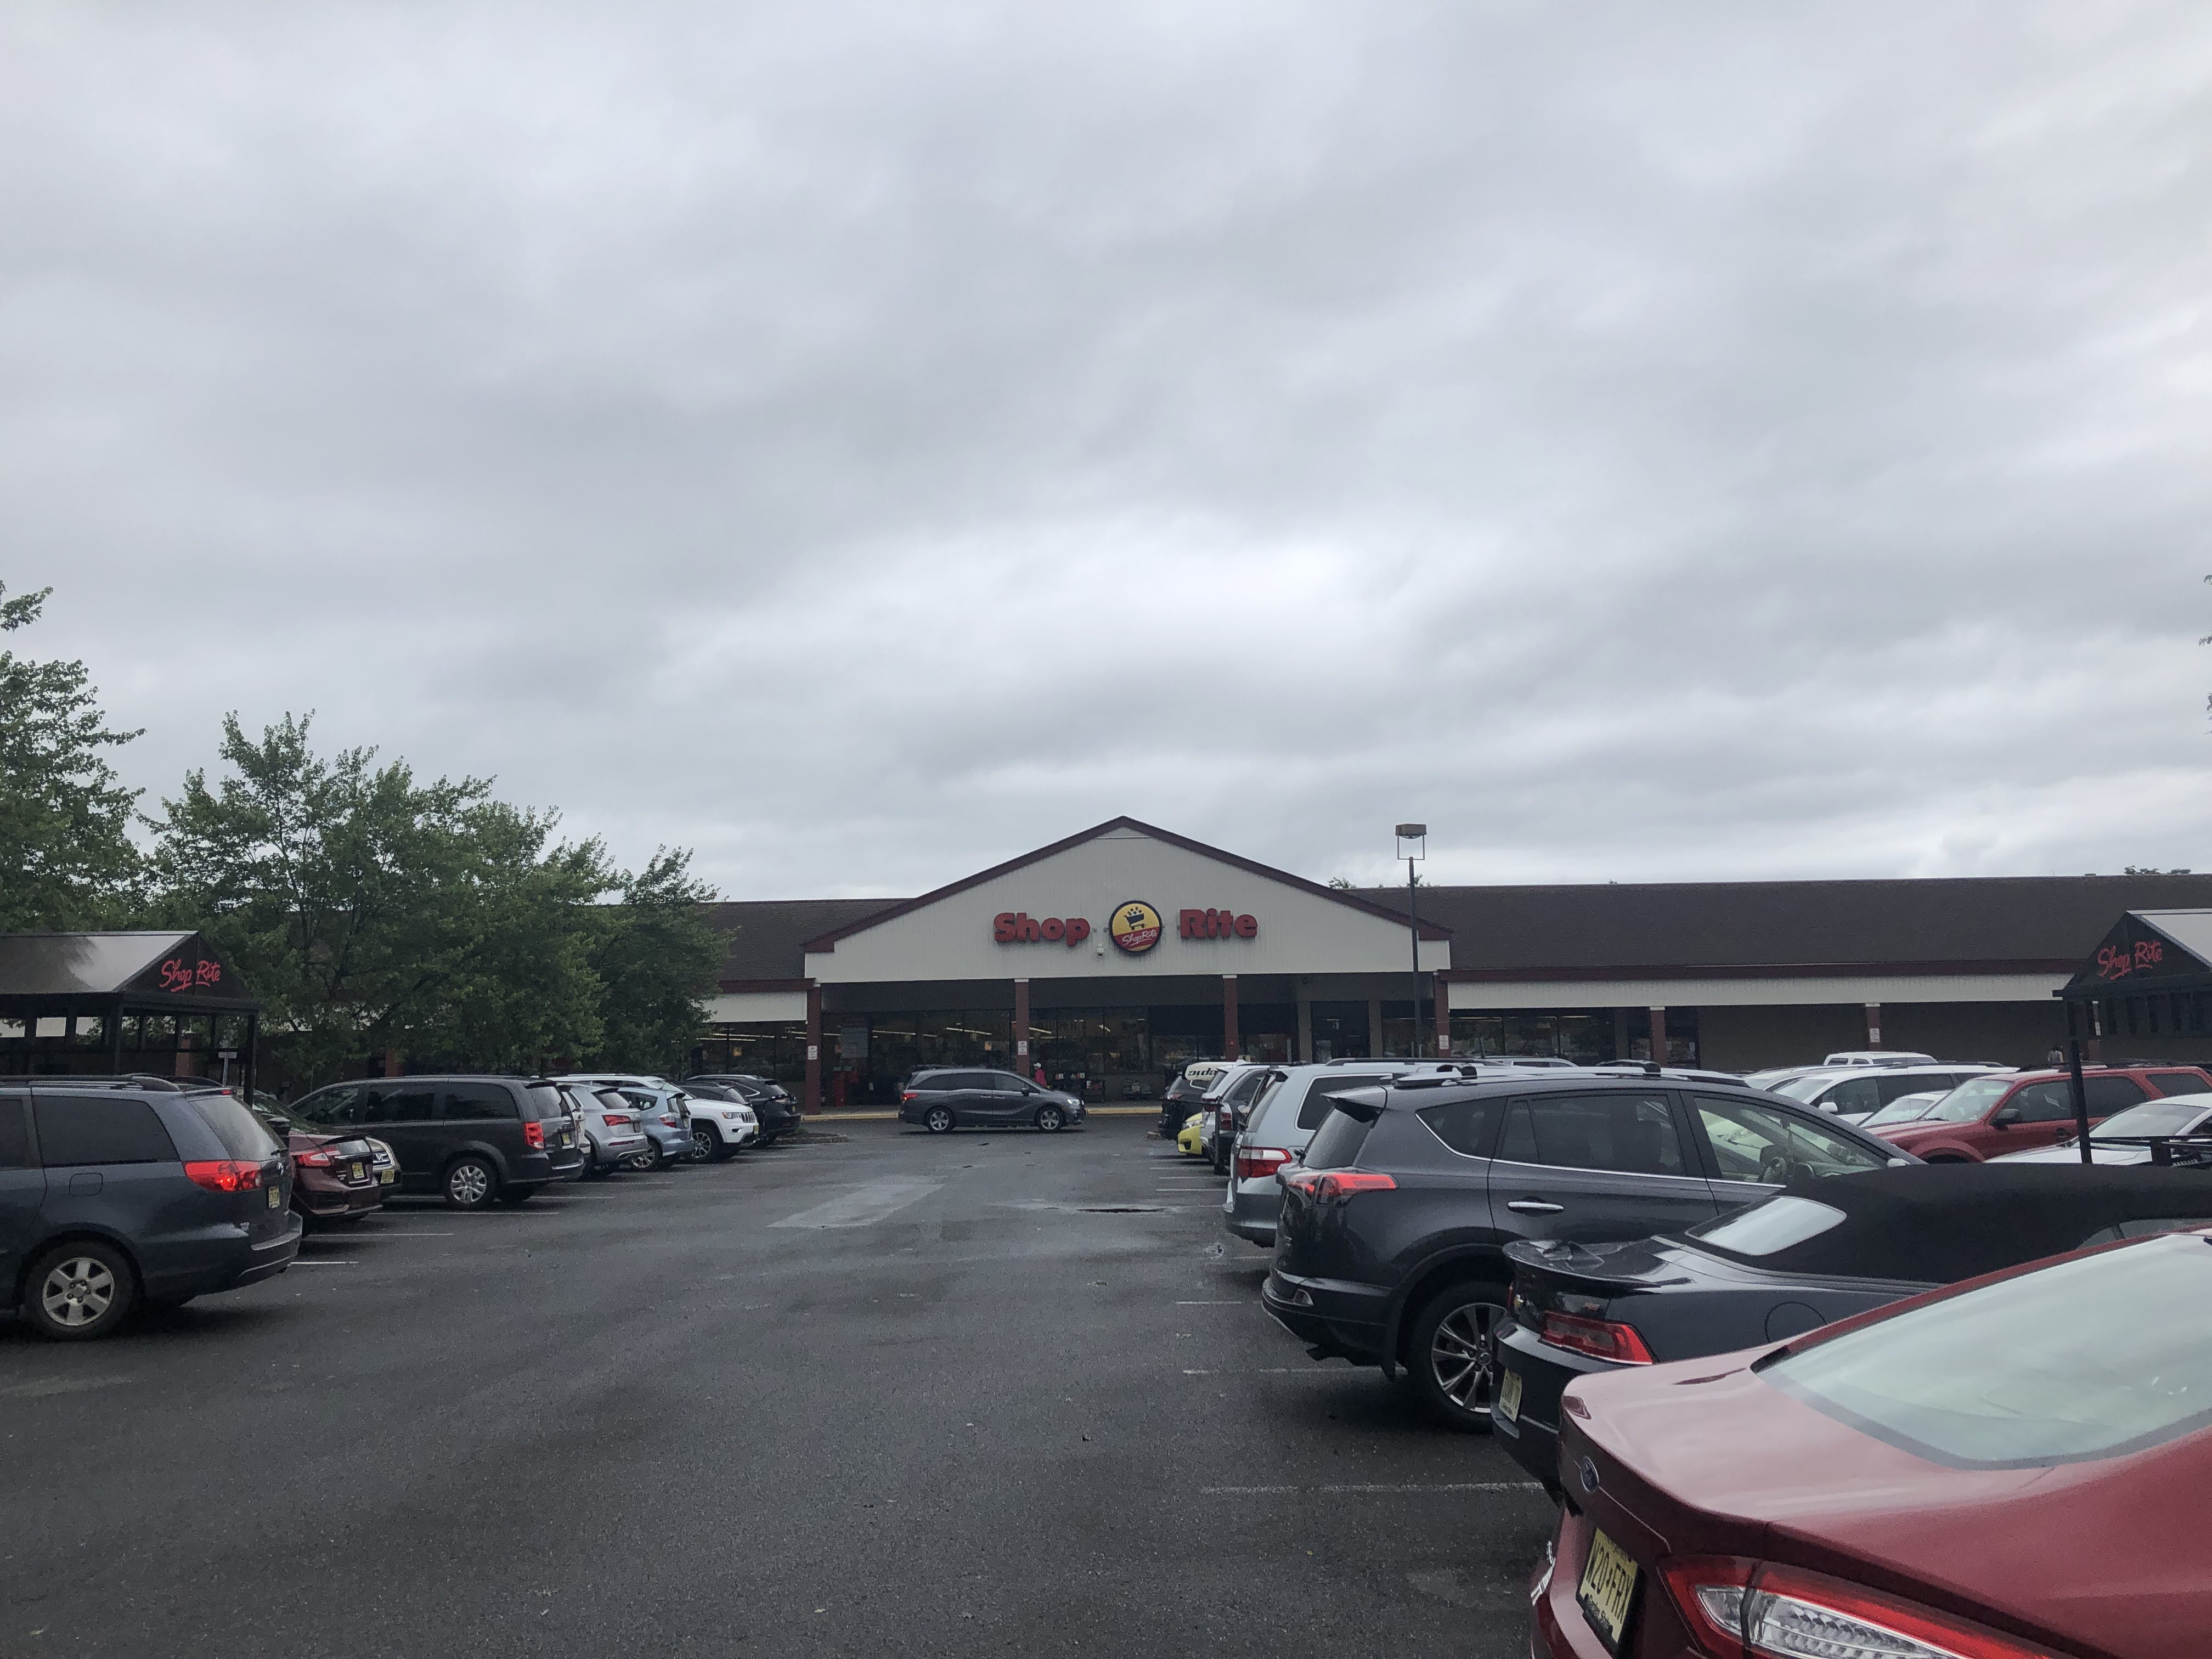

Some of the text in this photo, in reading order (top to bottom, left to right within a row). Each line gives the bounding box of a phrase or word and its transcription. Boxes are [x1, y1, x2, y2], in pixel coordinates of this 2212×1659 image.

[994, 907, 1259, 946] Shop Rite
[159, 958, 221, 992] Shop Rite
[2097, 941, 2162, 980] Shop Rite
